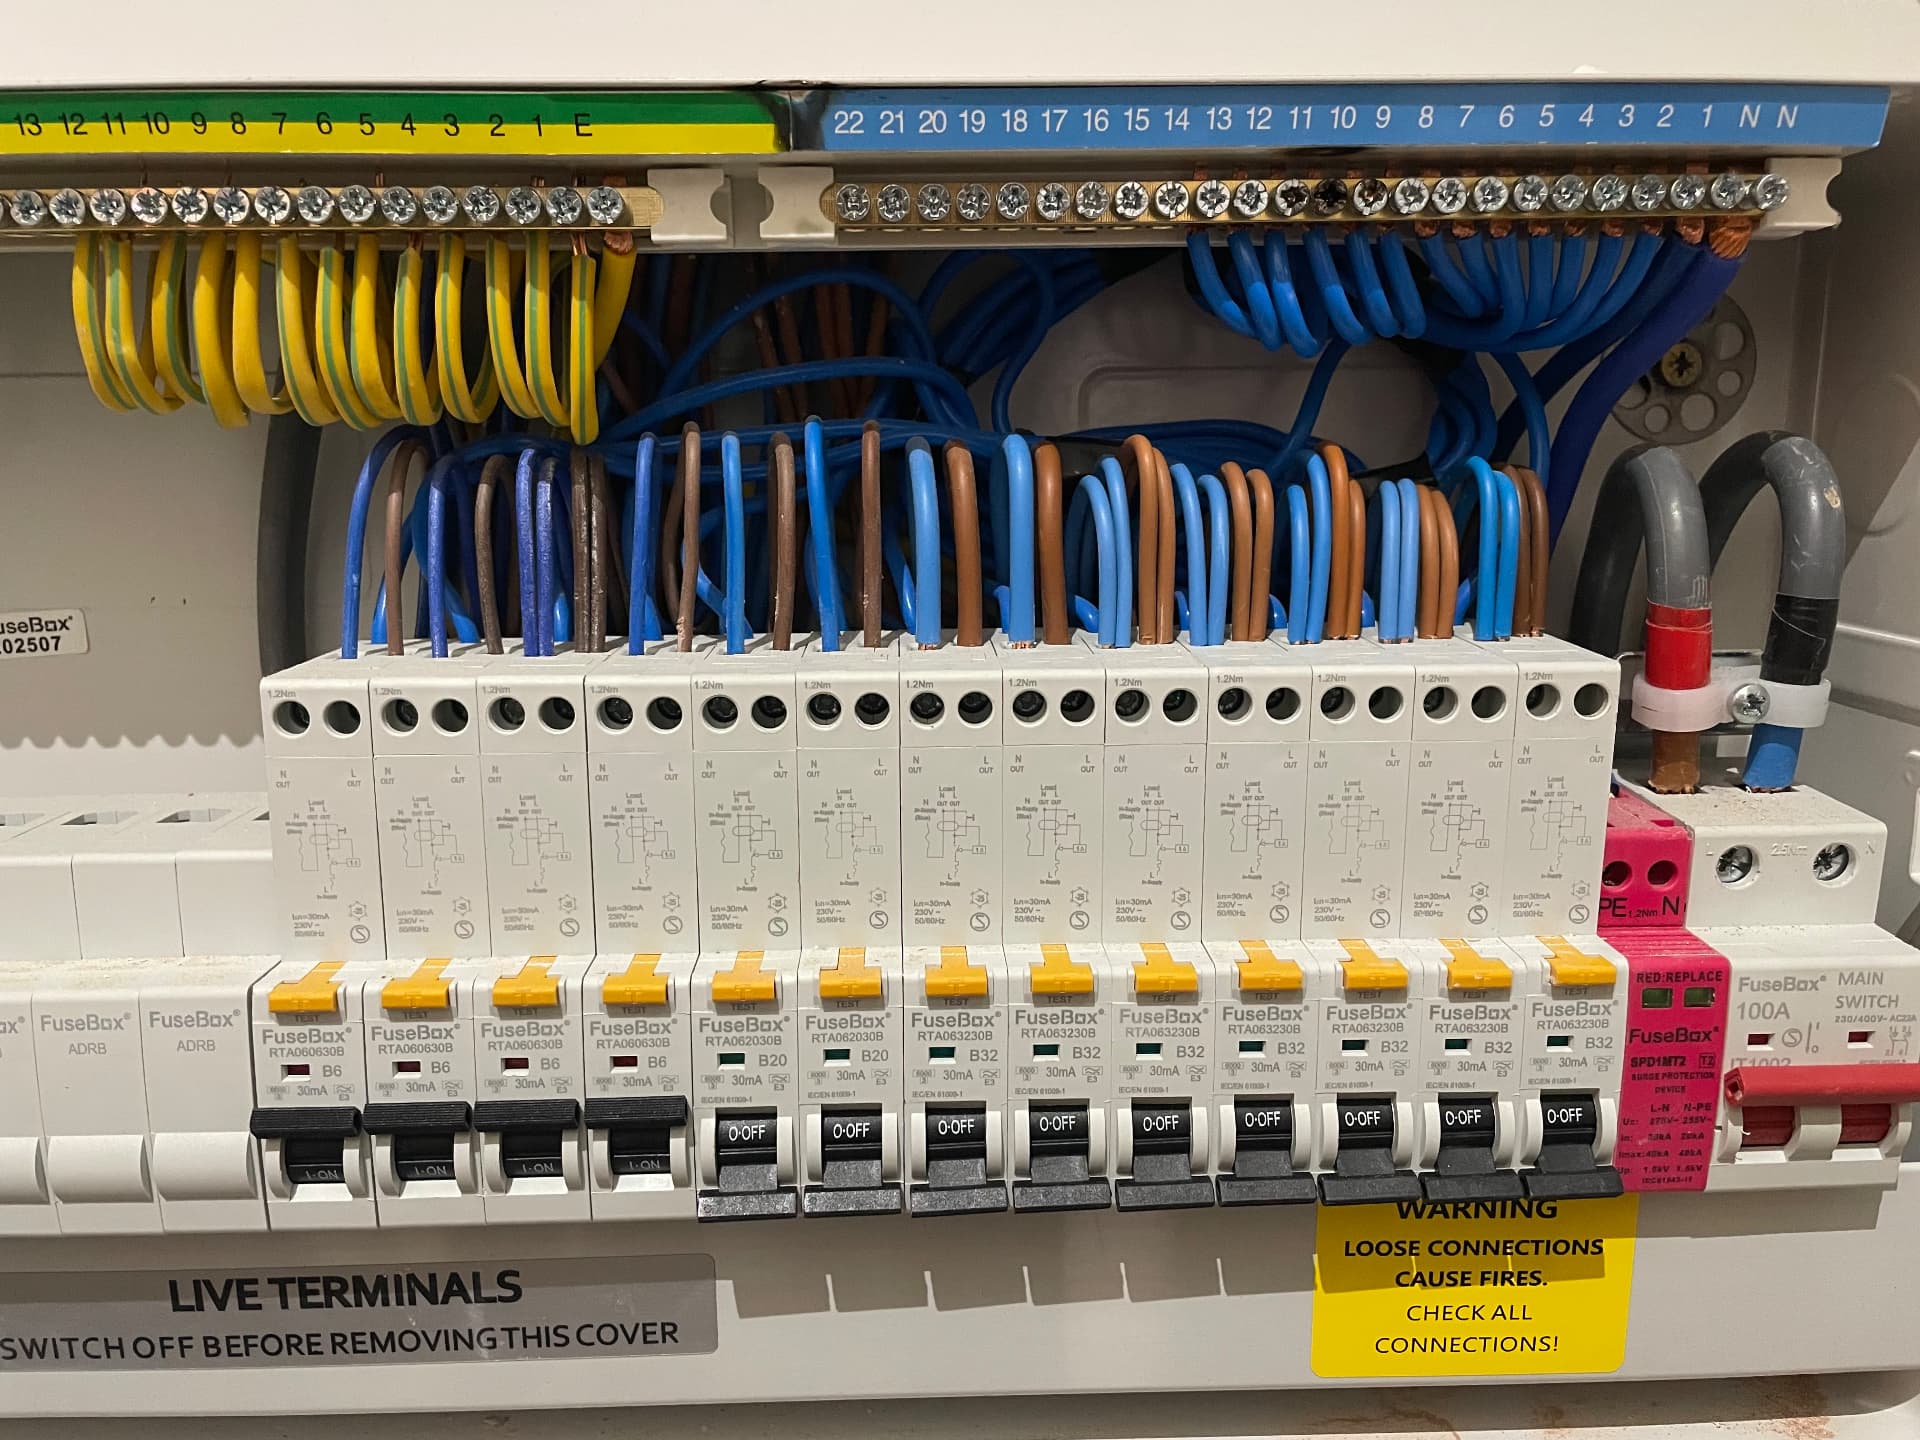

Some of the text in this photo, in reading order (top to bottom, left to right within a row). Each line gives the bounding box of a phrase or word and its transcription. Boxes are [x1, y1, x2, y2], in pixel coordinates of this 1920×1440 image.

[14, 112, 592, 136] 13 12 11 10 9 8 7 6 5 4 3 2 1 E
[834, 105, 1798, 134] 22 21 20 19 18 17 16 15 14 13 12 11 10 9 8 7 6 5 4 3 2 1 N N
[0, 616, 70, 635] useBox
[0, 635, 61, 654] 02507
[1663, 897, 1680, 916] N
[1838, 971, 1883, 986] MAIN
[1737, 995, 1899, 1020] 100A SWITCH
[1228, 1024, 1301, 1034] RTA063230B
[1332, 1023, 1404, 1033] RTA063230B
[1435, 1023, 1509, 1033] RTA063230B
[1537, 1019, 1609, 1031] RTA063230B
[812, 1032, 884, 1043] RTA062030B
[918, 1030, 993, 1041] RTA063230B
[1021, 1028, 1096, 1038] RTA063230B
[1125, 1027, 1200, 1038] RTA063230B
[176, 1040, 215, 1051] ADRB
[488, 1040, 563, 1051] RTA060630B
[596, 1038, 670, 1049] RTA060630B
[705, 1035, 782, 1046] RTA062030B
[1586, 1037, 1613, 1049] B32
[68, 1043, 107, 1055] ADRB
[269, 1047, 345, 1058] RTA060630B
[378, 1043, 453, 1055] RTA060630B
[1073, 1047, 1101, 1059] B32
[1177, 1046, 1205, 1058] B32
[1278, 1042, 1305, 1054] B32
[1381, 1041, 1409, 1053] B32
[1484, 1042, 1512, 1054] B32
[648, 1056, 667, 1068] B6
[759, 1054, 787, 1067] B20
[862, 1050, 889, 1062] B20
[969, 1050, 998, 1062] B32
[431, 1062, 451, 1074] B6
[541, 1058, 560, 1070] B6
[1251, 1062, 1280, 1073] 30mA
[1355, 1061, 1384, 1072] 30mA
[1457, 1061, 1487, 1072] 30mA
[1559, 1057, 1588, 1068] 30mA
[323, 1065, 342, 1077] B6
[837, 1070, 865, 1081] 30mA
[943, 1069, 973, 1081] 30mA
[1046, 1066, 1076, 1077] 30mA
[1150, 1065, 1180, 1076] 30mA
[515, 1078, 545, 1089] 30mA
[623, 1076, 652, 1087] 30mA
[732, 1075, 762, 1086] 30mA
[297, 1085, 328, 1096] 30mA
[406, 1082, 436, 1093] 30mA
[1396, 1199, 1558, 1219] WARNING
[1344, 1239, 1604, 1257] LOOSE CONNECTIONS
[1395, 1270, 1548, 1288] CAUSE FIRES.
[168, 1270, 523, 1312] LIVE TERMINALS
[1406, 1304, 1533, 1321] CHECK ALL
[0, 1321, 680, 1360] SWITCH OFF BEFORE REMOVING THIS COVER
[1375, 1335, 1559, 1354] CONNECTIONS!
